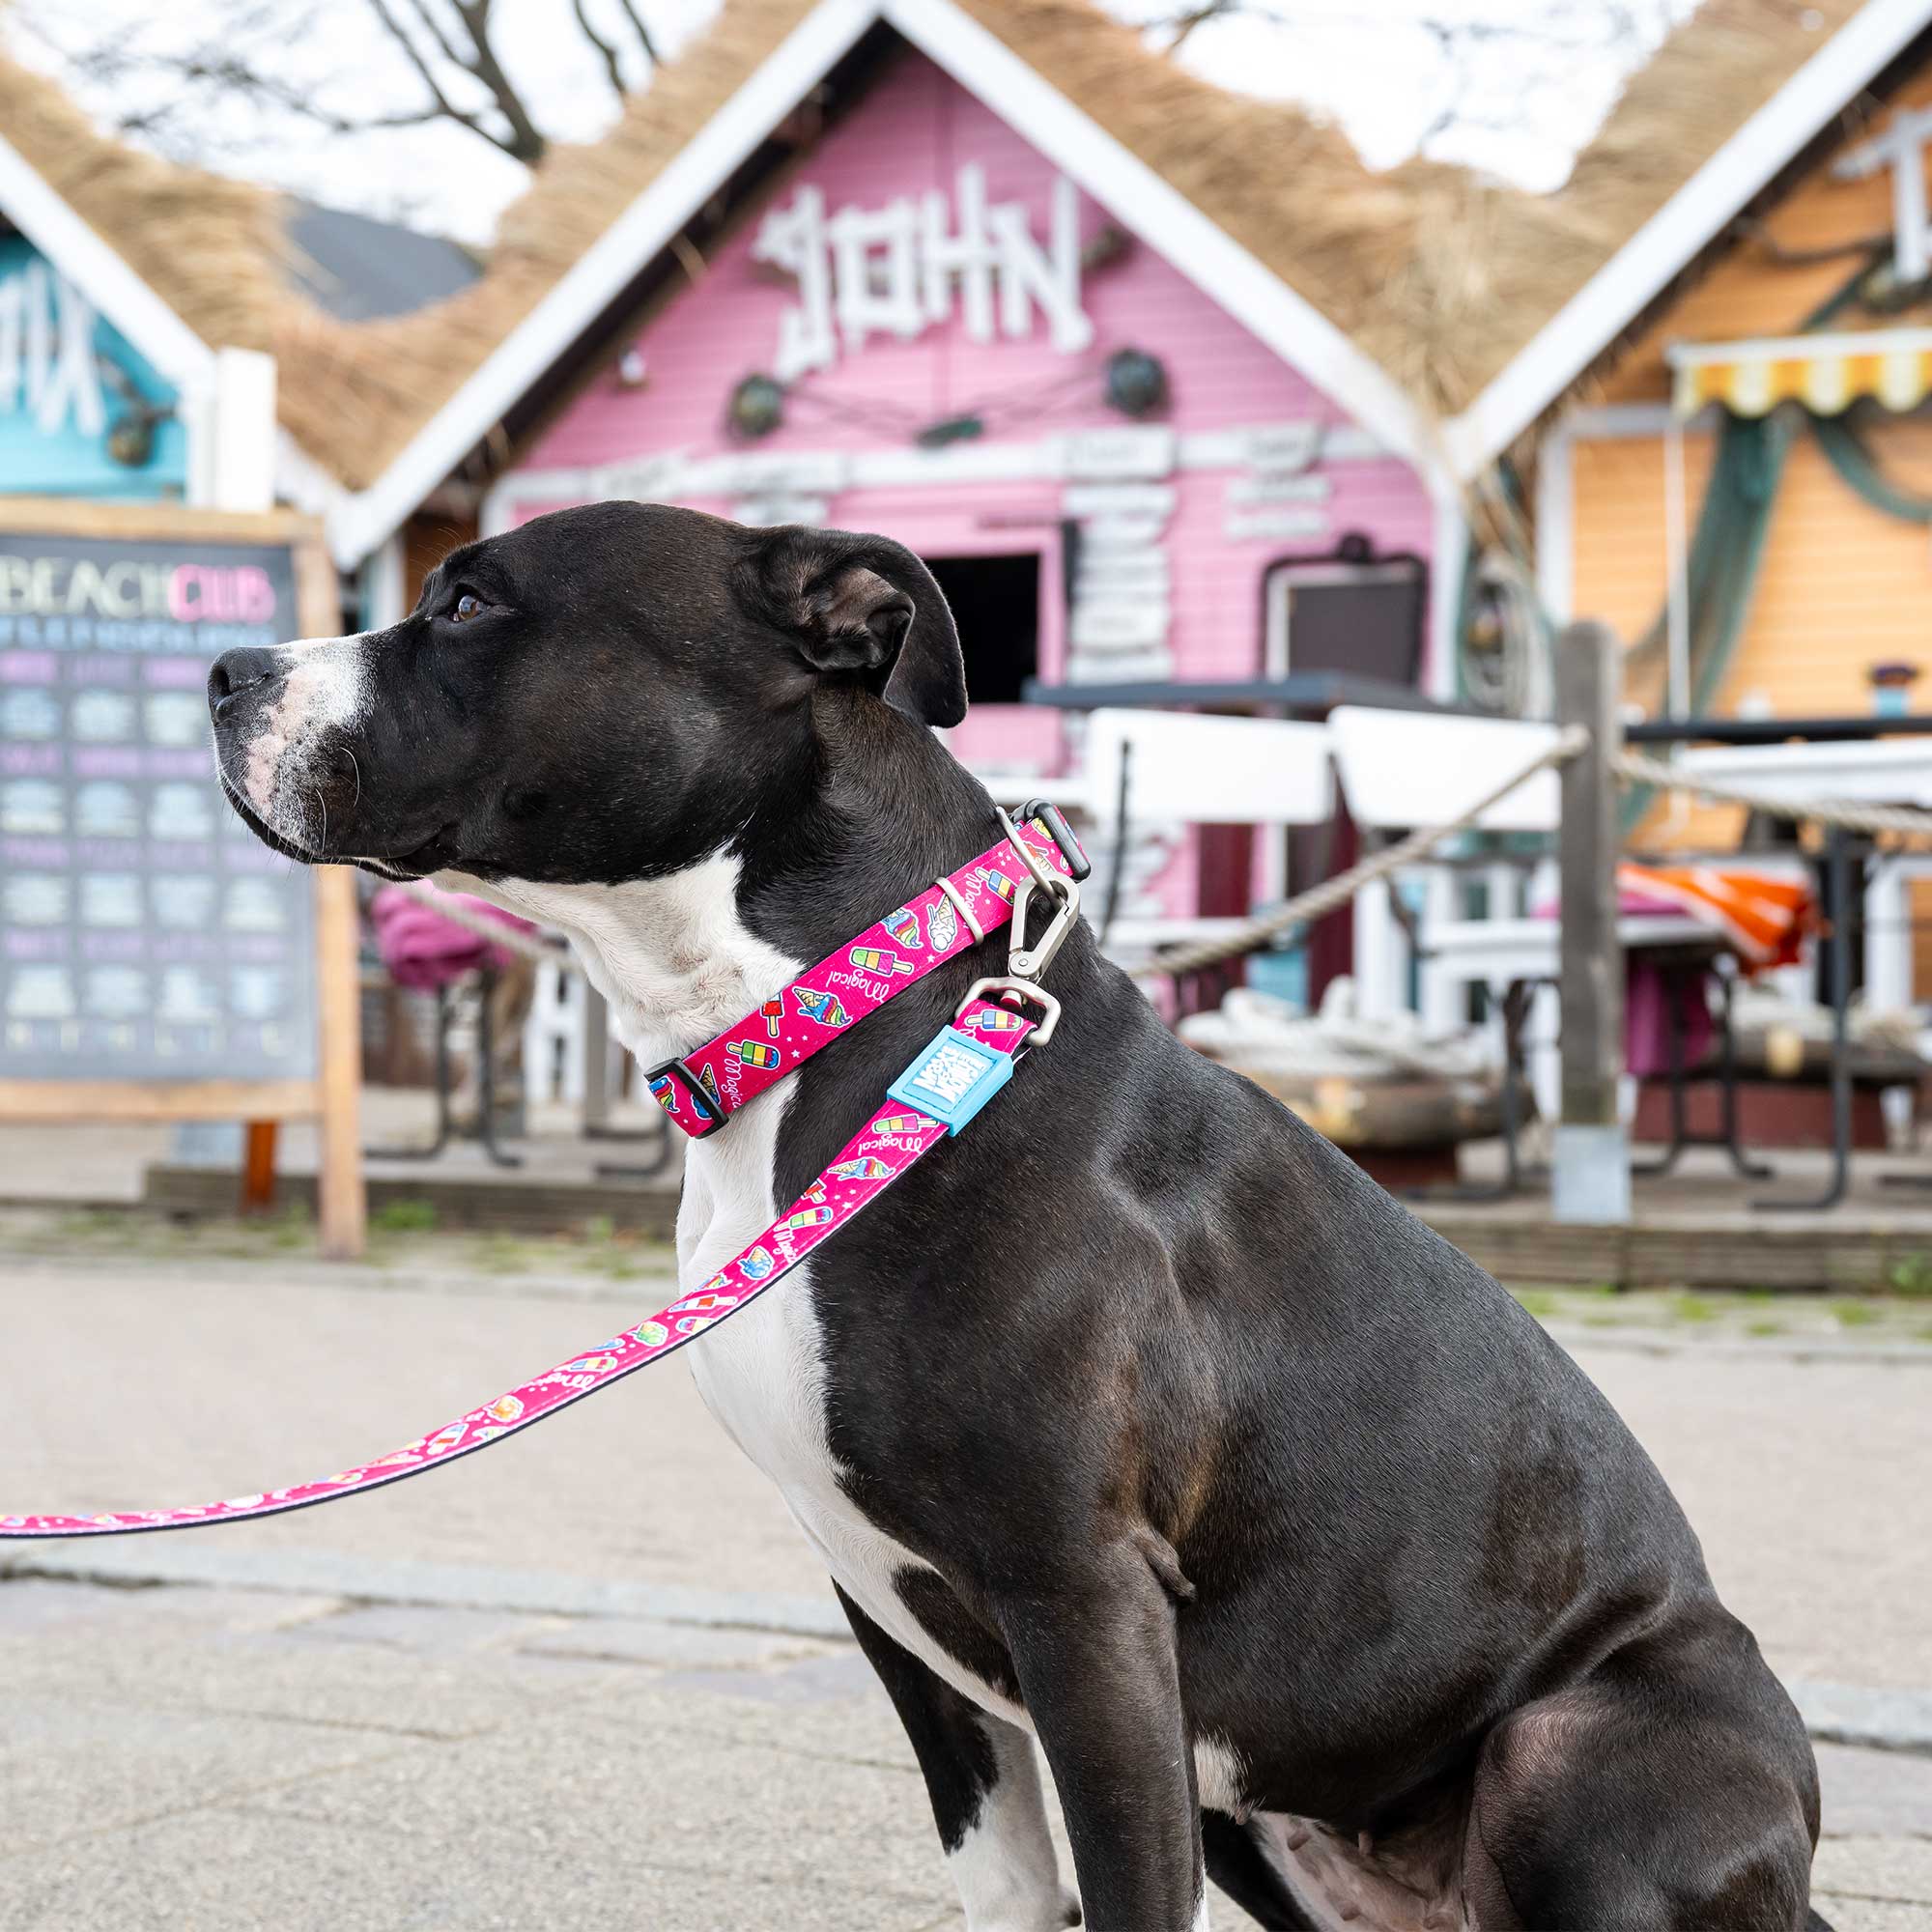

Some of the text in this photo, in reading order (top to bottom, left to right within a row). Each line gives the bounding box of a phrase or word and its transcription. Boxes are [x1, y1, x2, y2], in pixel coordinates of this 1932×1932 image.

[752, 162, 1094, 383] JOHN
[825, 969, 890, 1004] Magical
[857, 1133, 923, 1156] Magical
